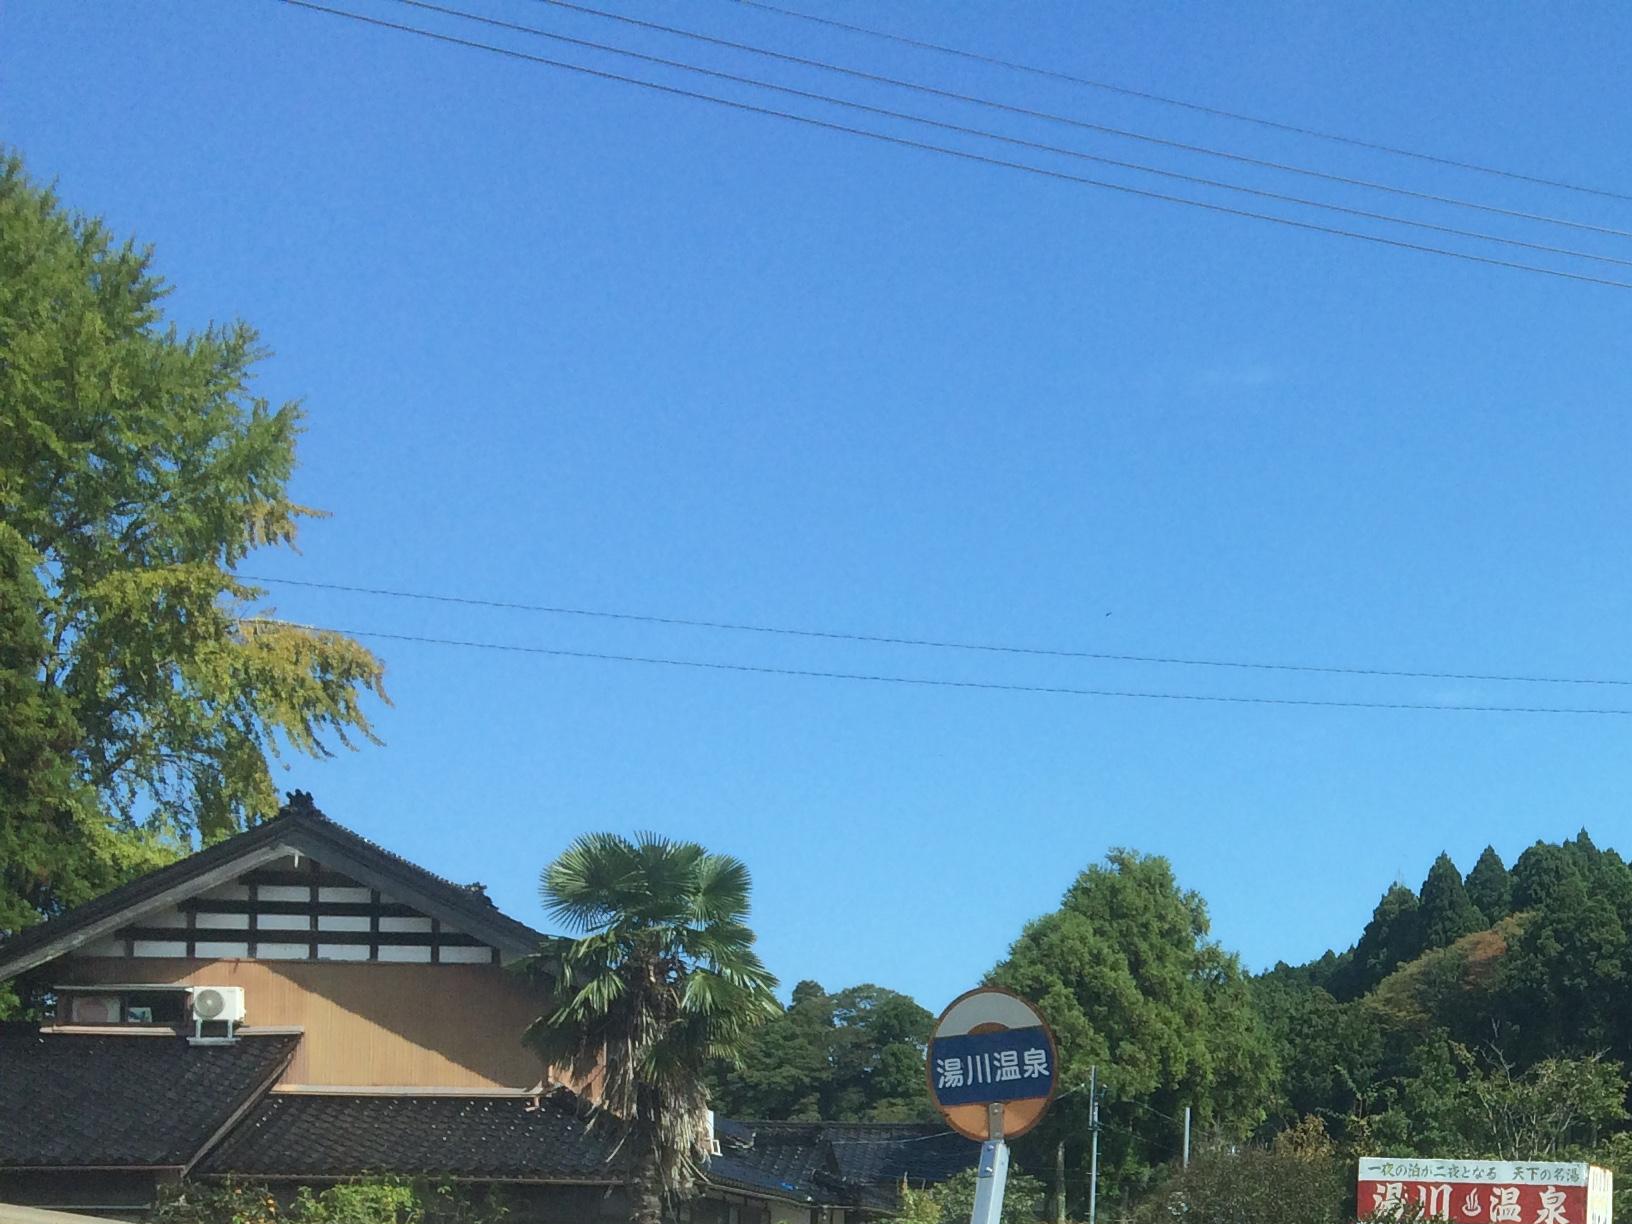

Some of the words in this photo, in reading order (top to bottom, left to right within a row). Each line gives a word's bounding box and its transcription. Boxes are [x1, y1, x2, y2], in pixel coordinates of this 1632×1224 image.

[937, 1048, 1049, 1088] 湯川温泉
[1512, 1166, 1580, 1183] 天下の名湯
